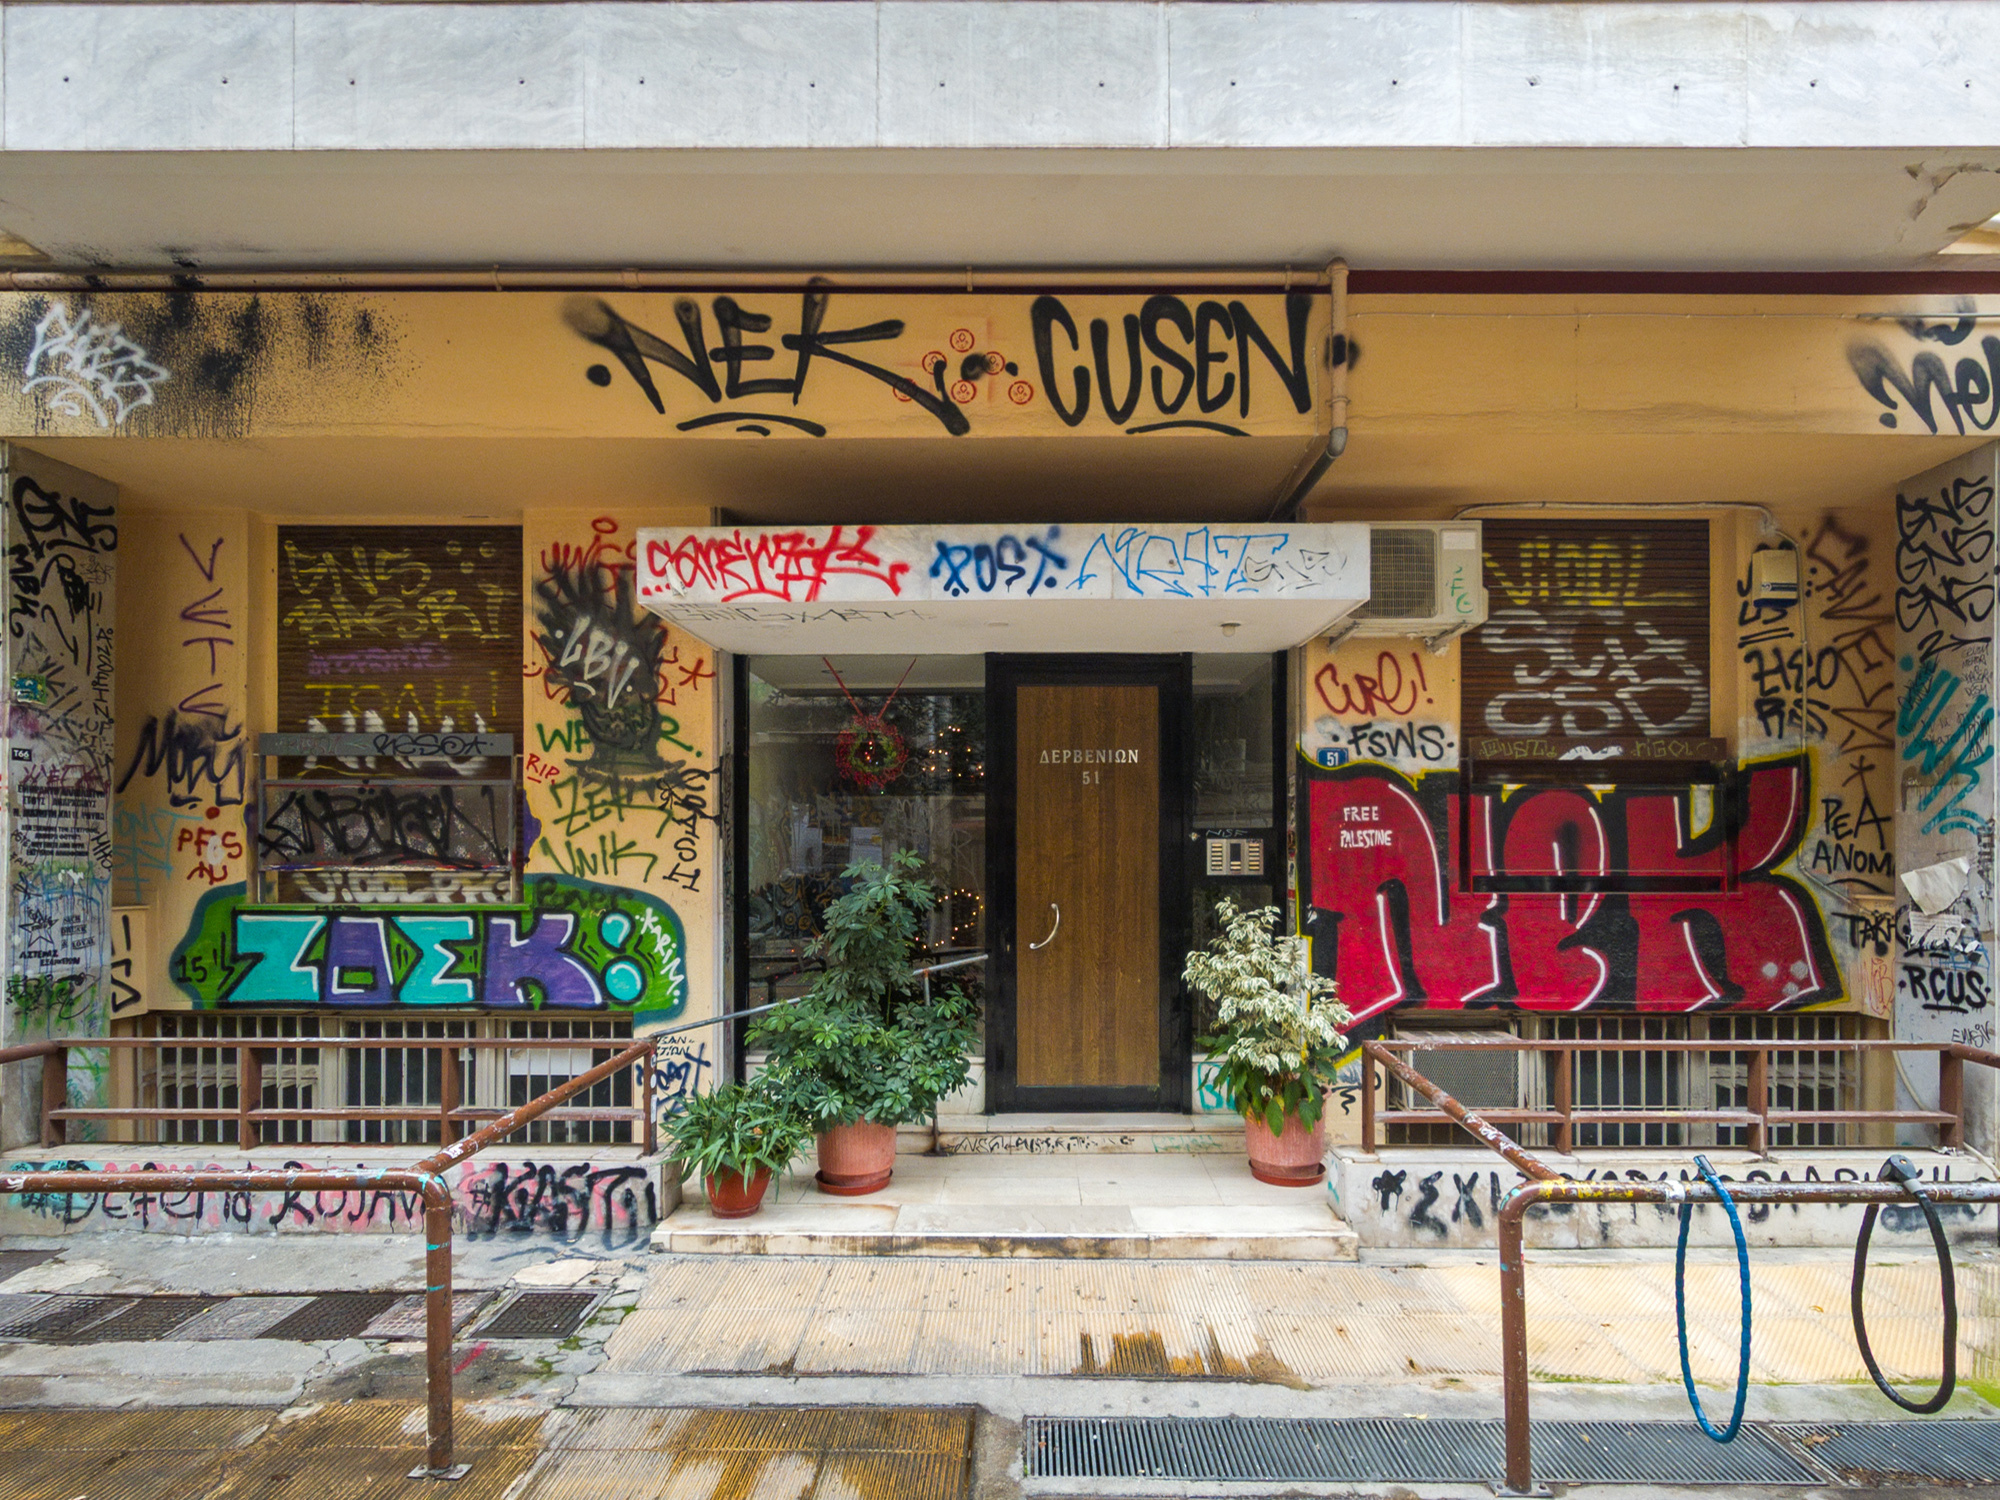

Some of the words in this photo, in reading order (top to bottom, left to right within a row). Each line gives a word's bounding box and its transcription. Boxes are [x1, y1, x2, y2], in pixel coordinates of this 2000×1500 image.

[1031, 292, 1313, 427] CUSEN
[1039, 749, 1139, 764] ΔΕΡΒΕΝΙΩΝ
[1326, 752, 1340, 767] 51
[1082, 771, 1100, 785] 51
[1343, 806, 1380, 821] FREE
[1340, 829, 1394, 849] PALESTINE
